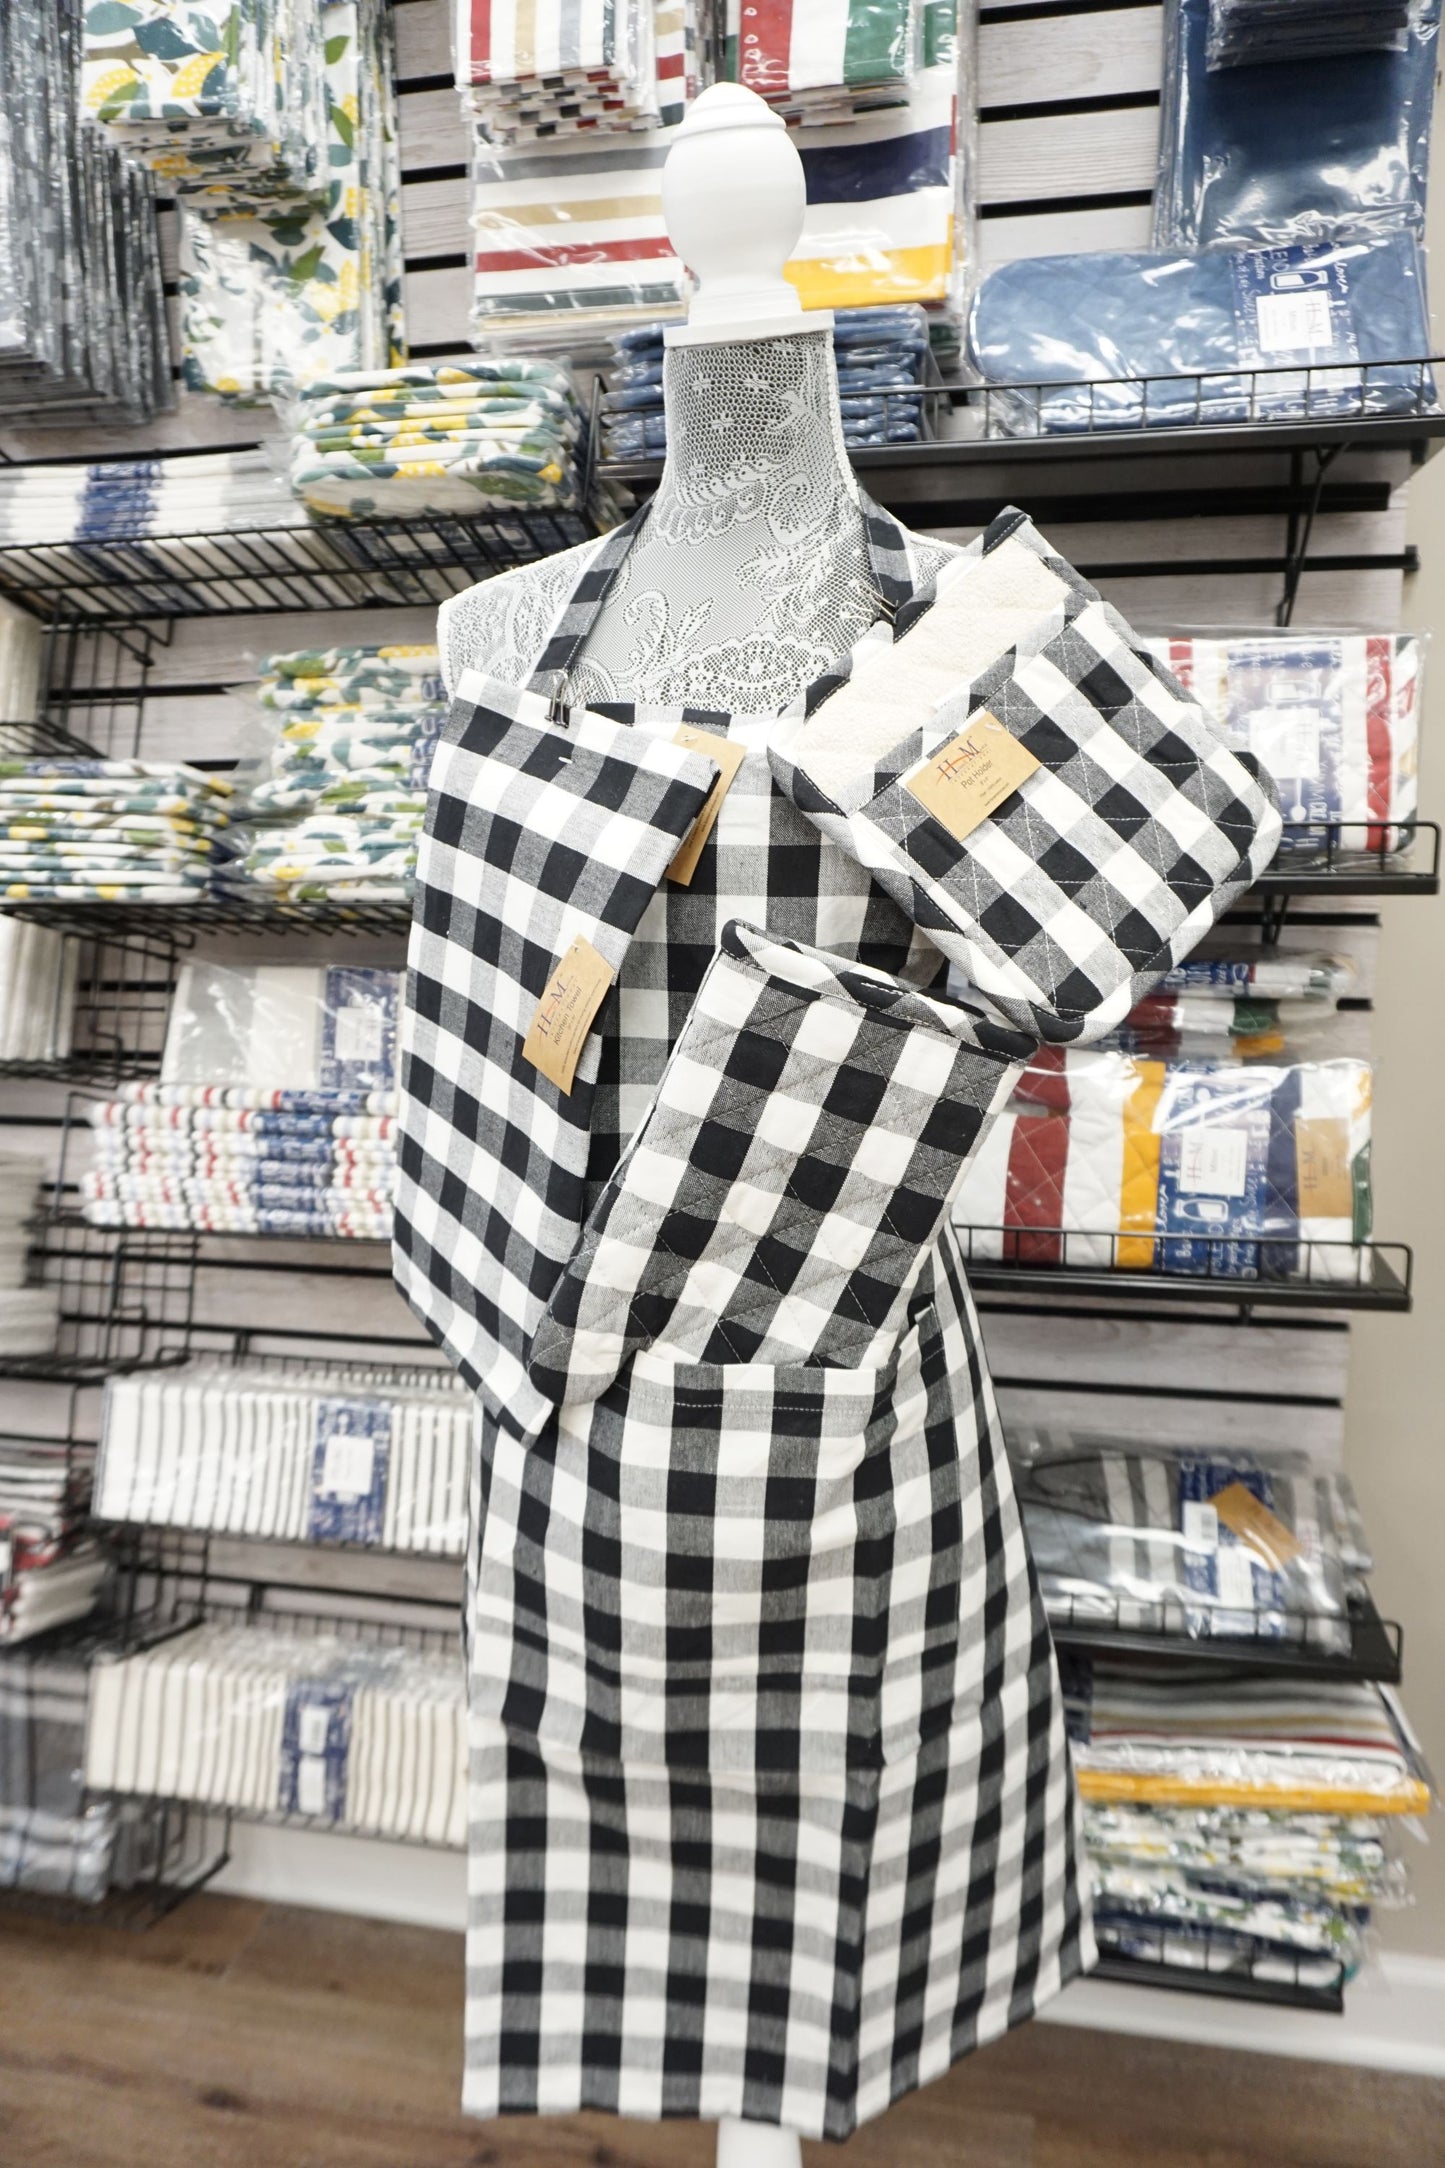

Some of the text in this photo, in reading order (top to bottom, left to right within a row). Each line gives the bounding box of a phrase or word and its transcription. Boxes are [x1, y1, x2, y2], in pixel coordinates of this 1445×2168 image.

[960, 774, 974, 790] Pot
[972, 759, 994, 779] Holder
[553, 1011, 570, 1046] Kitchen
[566, 986, 582, 1012] Towel
